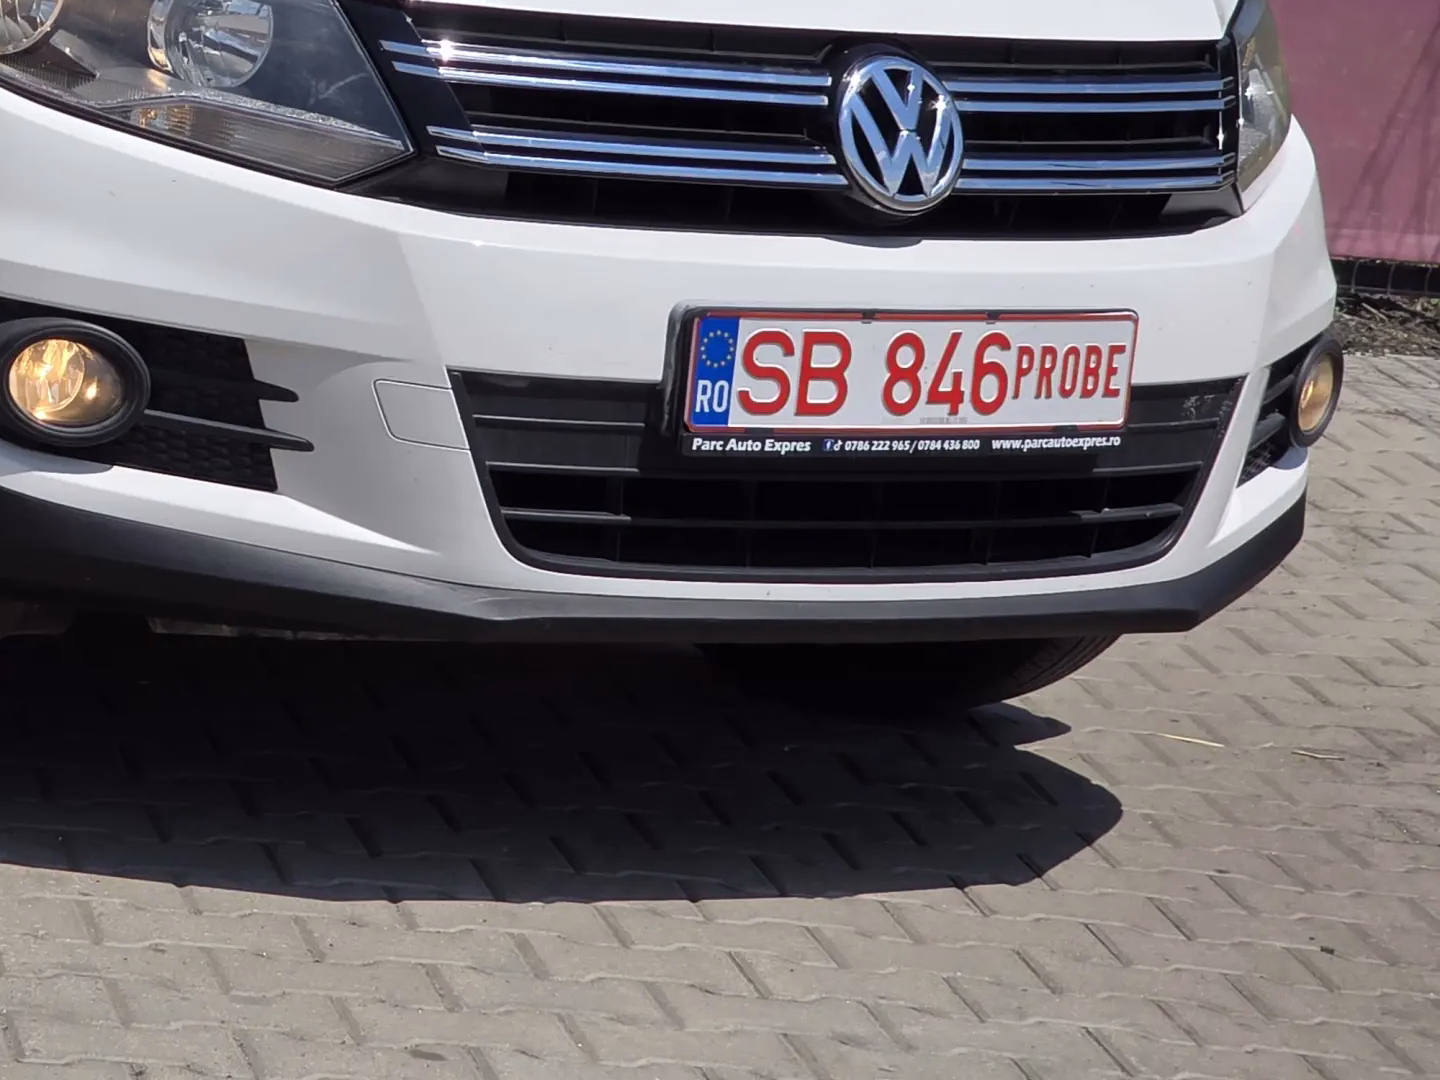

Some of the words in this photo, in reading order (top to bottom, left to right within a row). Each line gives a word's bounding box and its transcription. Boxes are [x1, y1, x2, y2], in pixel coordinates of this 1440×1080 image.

[839, 56, 963, 210] VW
[695, 379, 730, 413] RO
[737, 328, 852, 416] SB
[882, 329, 1012, 416] 846
[1012, 343, 1127, 400] PROBE
[692, 437, 724, 452] Parc
[725, 438, 762, 452] Auto
[764, 438, 812, 455] Expres
[844, 440, 870, 451] 0786
[870, 440, 891, 451] 222
[917, 439, 942, 451] 0784
[943, 439, 961, 450] 436
[961, 438, 981, 450] 800
[991, 436, 1121, 452] www.parcautoexpres.ro
